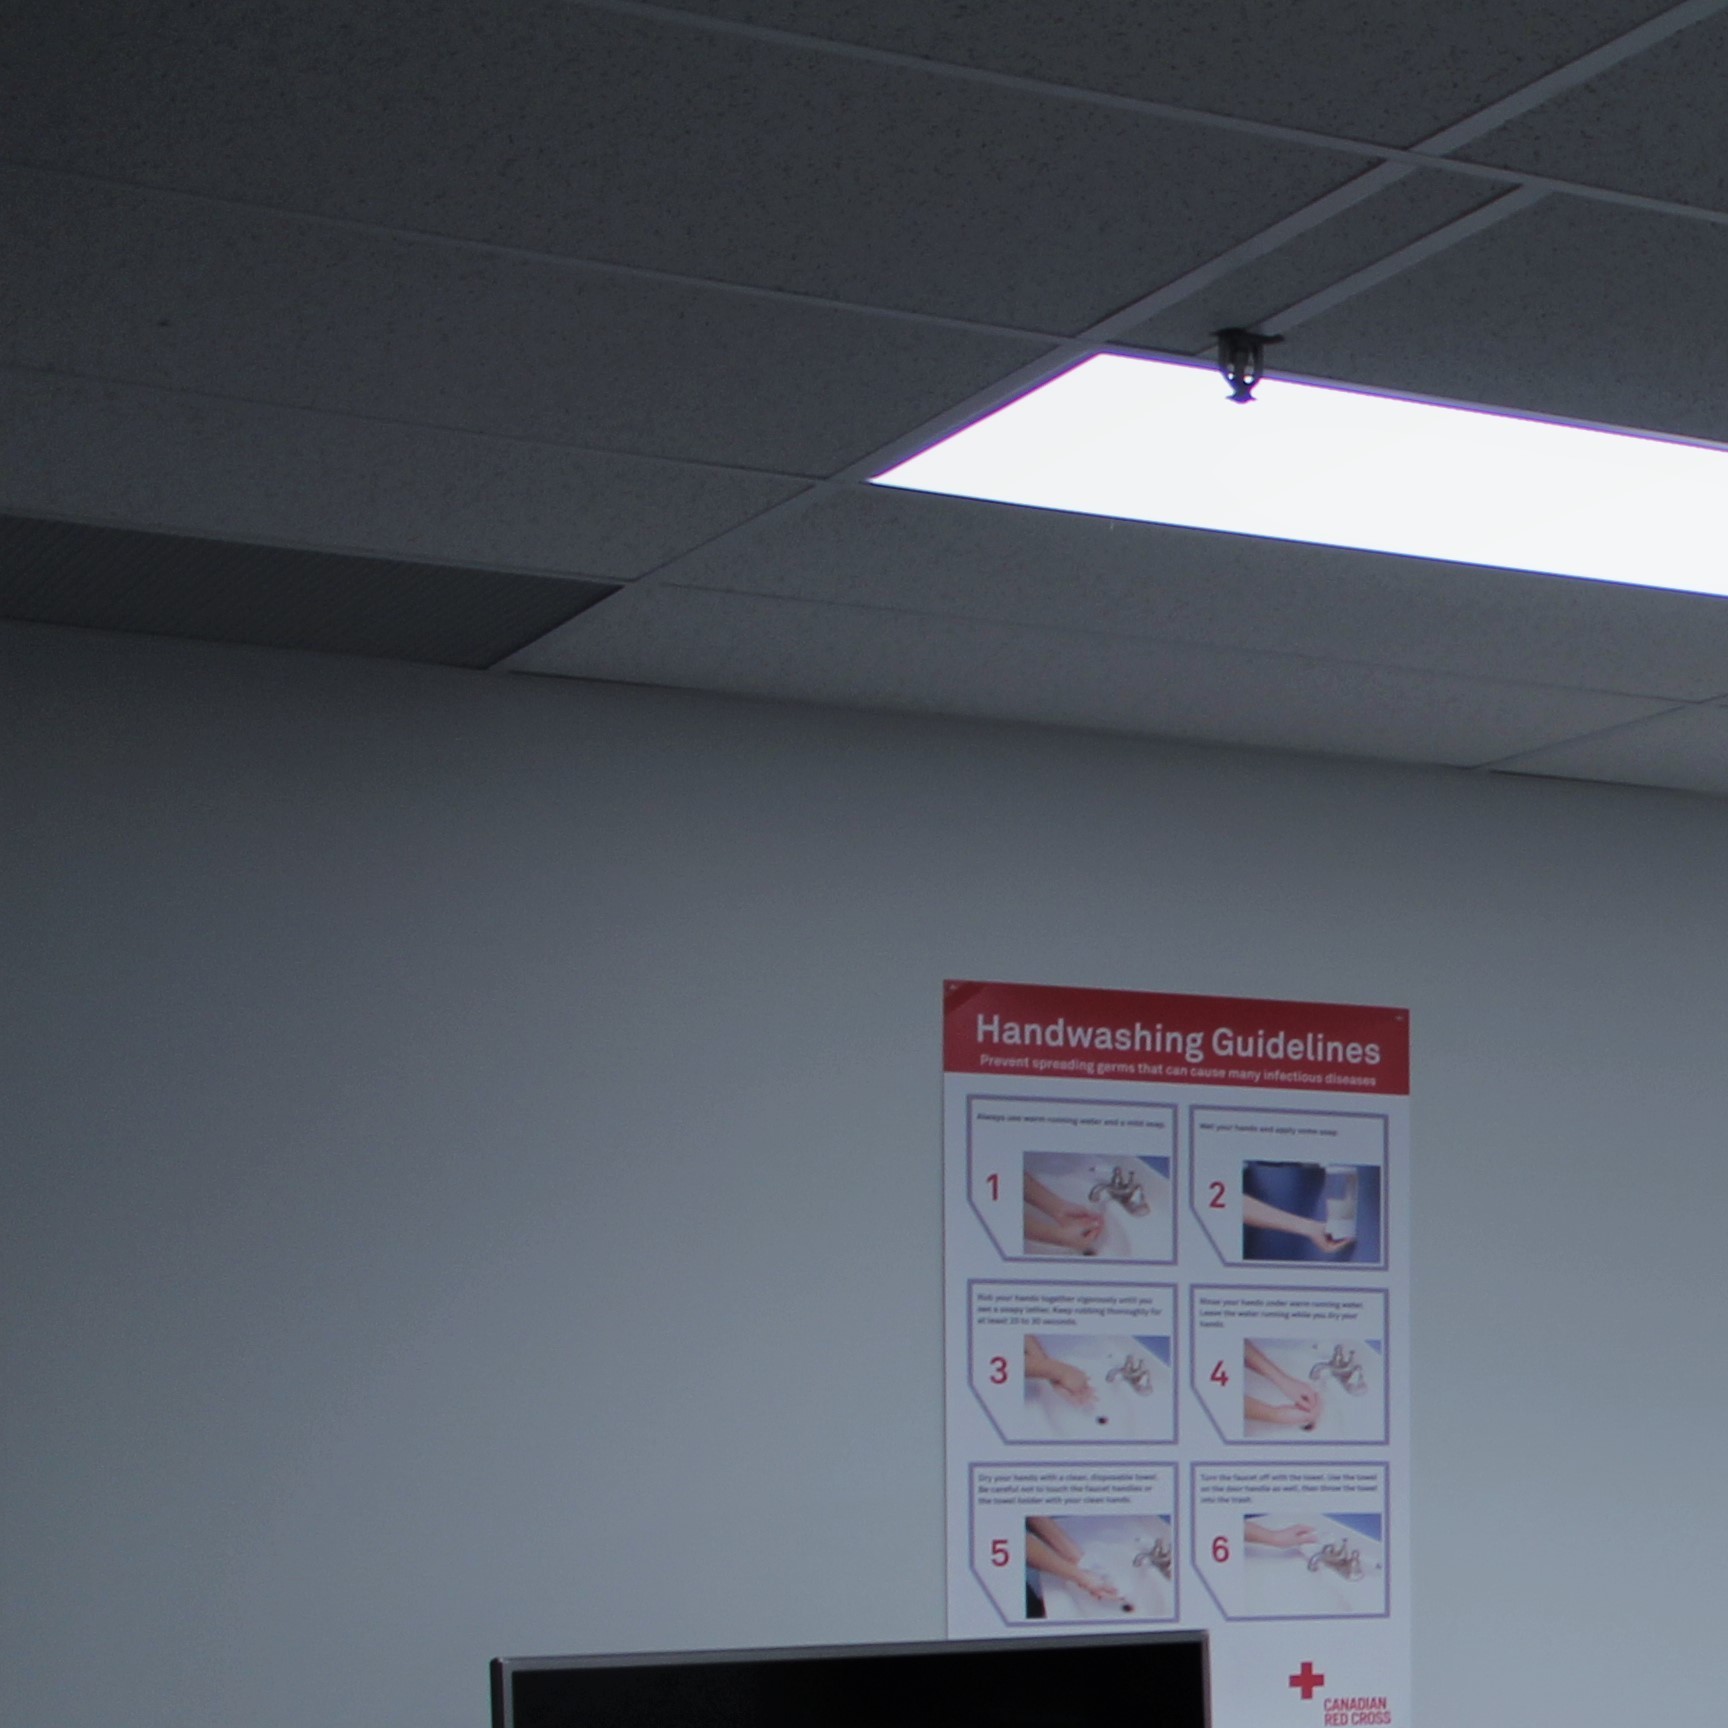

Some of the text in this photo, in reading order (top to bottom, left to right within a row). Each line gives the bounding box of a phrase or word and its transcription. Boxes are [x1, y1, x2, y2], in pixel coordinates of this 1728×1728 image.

[976, 1014, 1381, 1065] Handwashing Guidelines
[980, 1054, 1377, 1087] Prevent spreading germs that can cause many infectious diseases
[986, 1173, 1000, 1201] 1
[1209, 1181, 1227, 1209] 2
[989, 1356, 1008, 1384] 3
[1209, 1360, 1230, 1386] 4
[991, 1540, 1010, 1567] 5
[1212, 1536, 1230, 1564] 6
[1324, 1696, 1387, 1712] CANADIAN
[1324, 1710, 1392, 1727] RED CROSS
